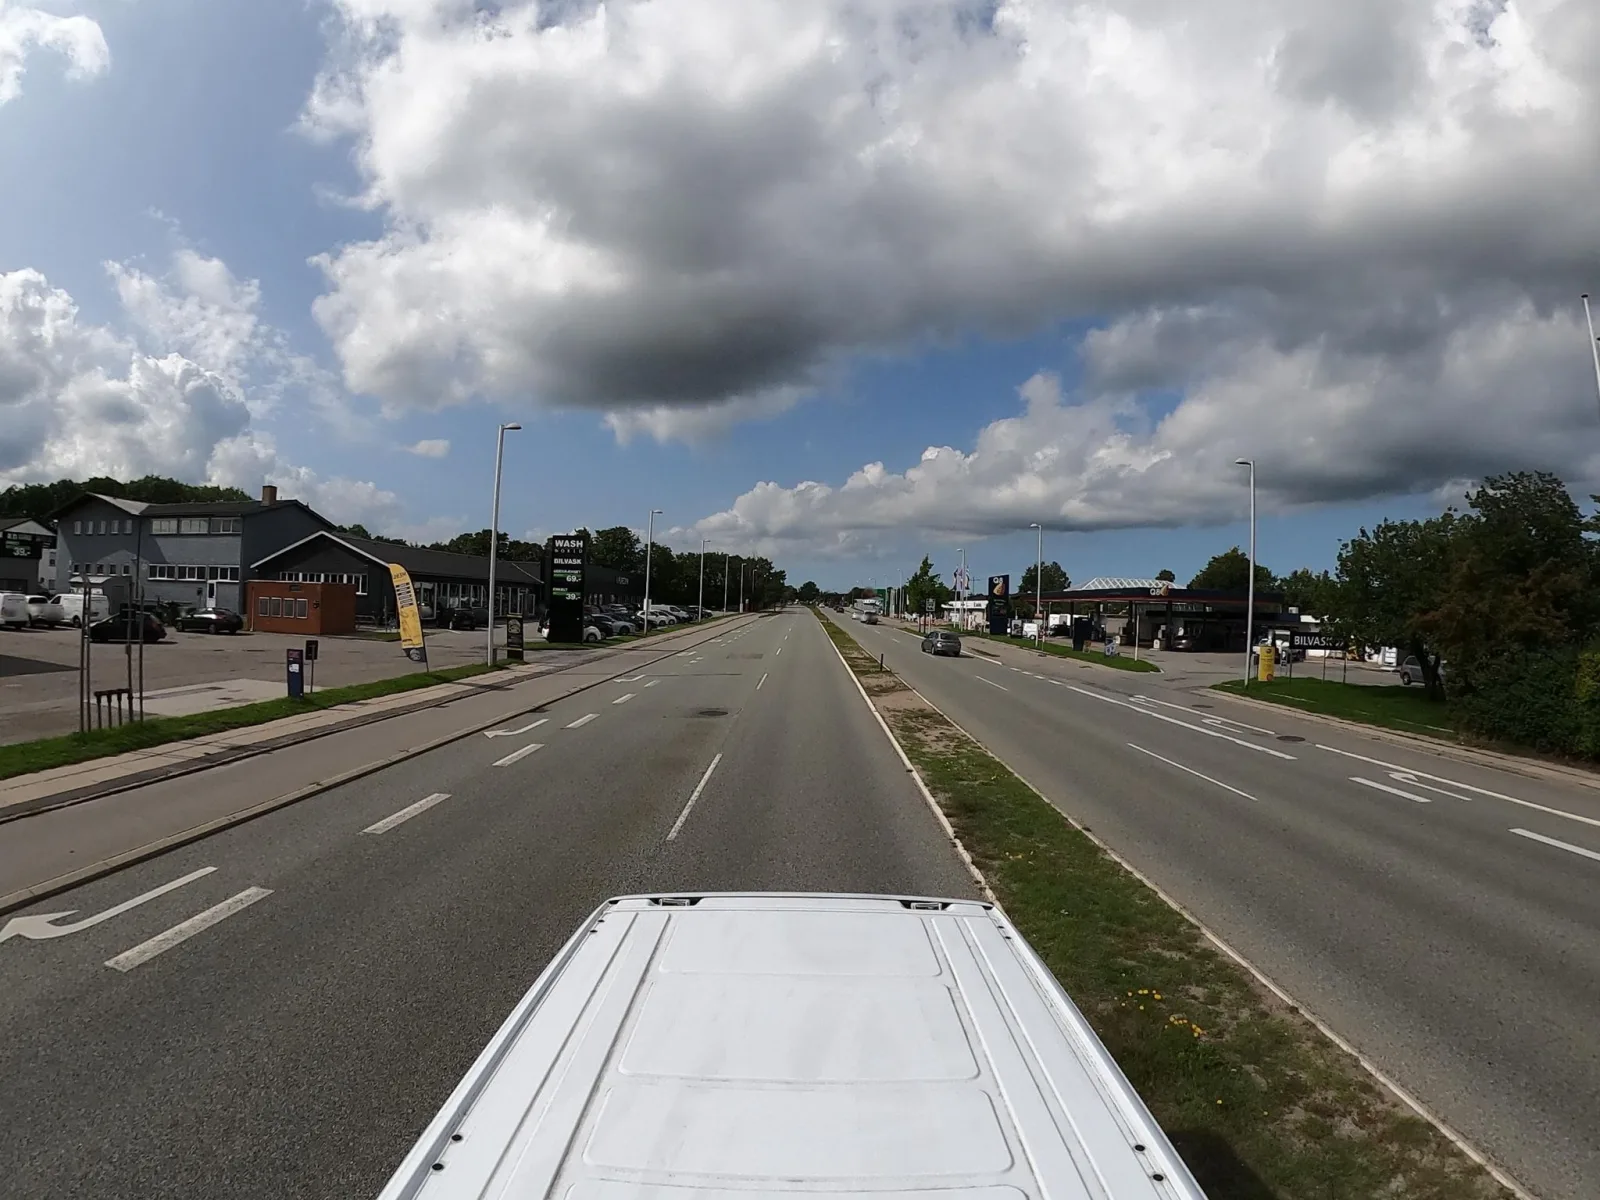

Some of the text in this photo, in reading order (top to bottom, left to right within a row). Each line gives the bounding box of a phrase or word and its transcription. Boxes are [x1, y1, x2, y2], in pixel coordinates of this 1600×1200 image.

[554, 540, 583, 548] WASH
[1149, 588, 1160, 596] Q8
[1294, 636, 1333, 647] BILVASK
